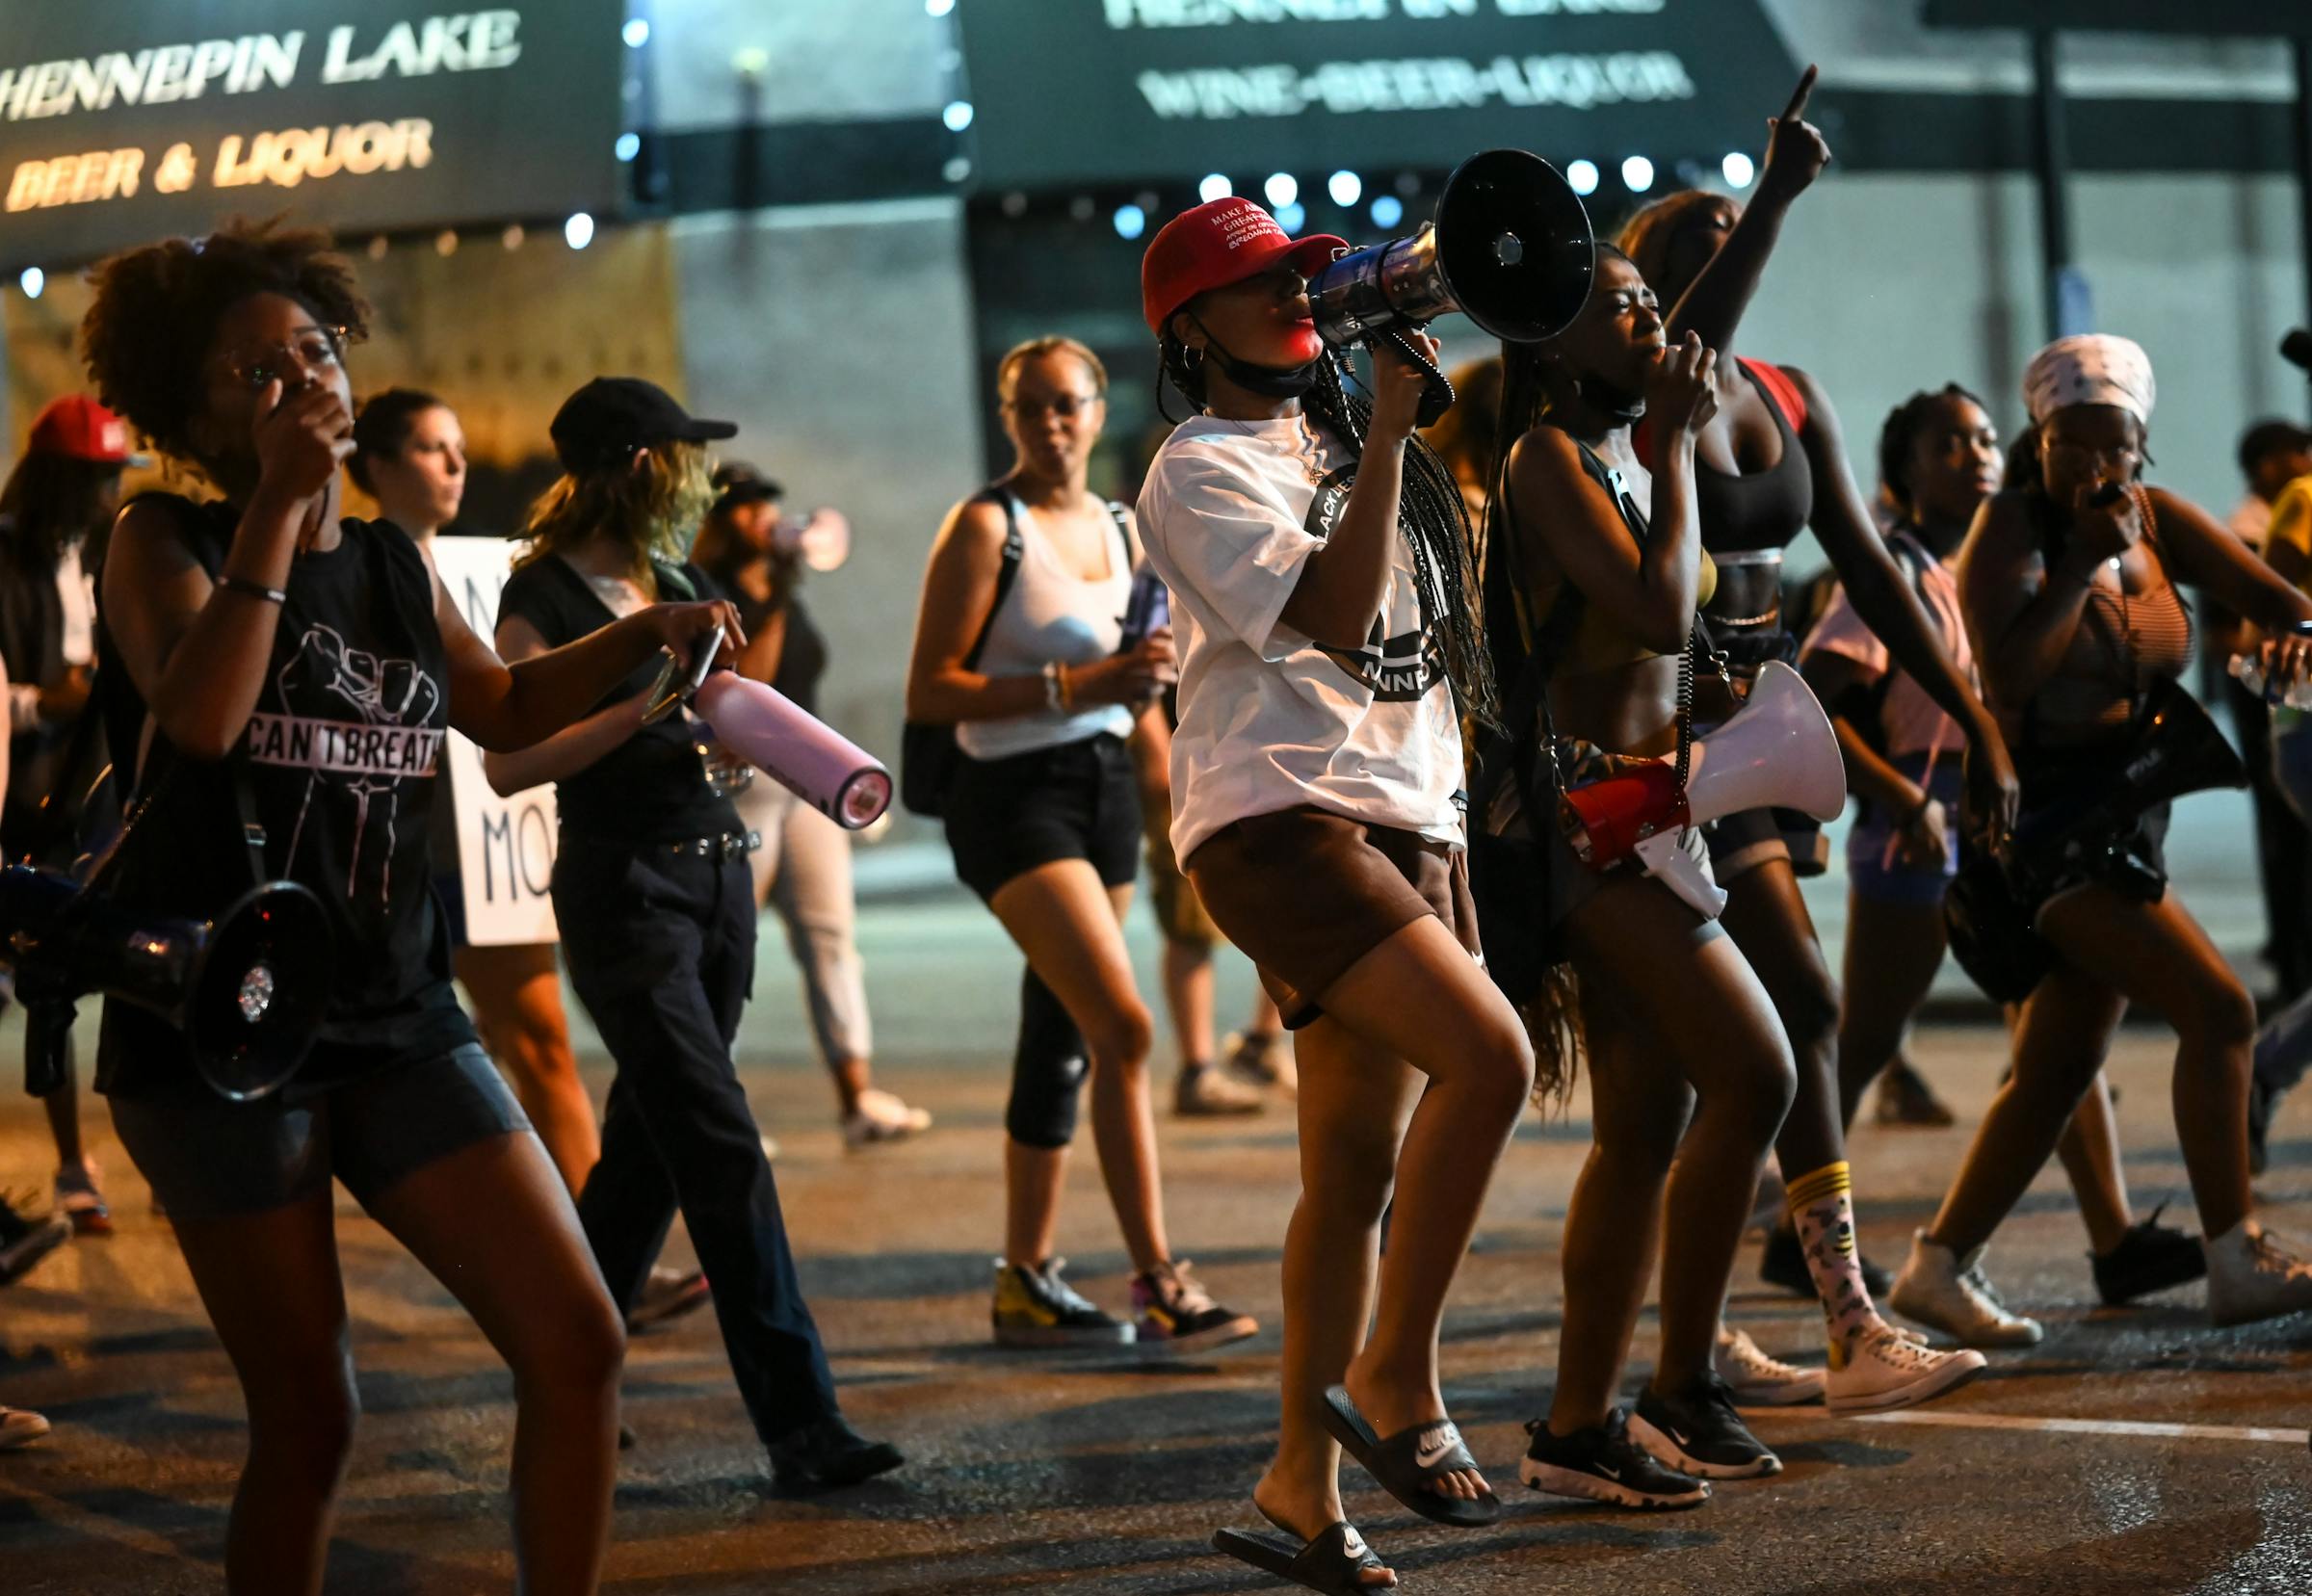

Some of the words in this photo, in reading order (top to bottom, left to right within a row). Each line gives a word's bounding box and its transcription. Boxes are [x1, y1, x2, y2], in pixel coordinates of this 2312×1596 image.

[0, 30, 306, 121] HENNEPIN
[321, 9, 522, 85] LAKE
[5, 146, 144, 213] BEER
[154, 141, 197, 195] &
[212, 117, 434, 189] LIQUOR
[1211, 207, 1244, 225] MAKE
[1316, 490, 1337, 544] LACK
[483, 804, 552, 903] MO
